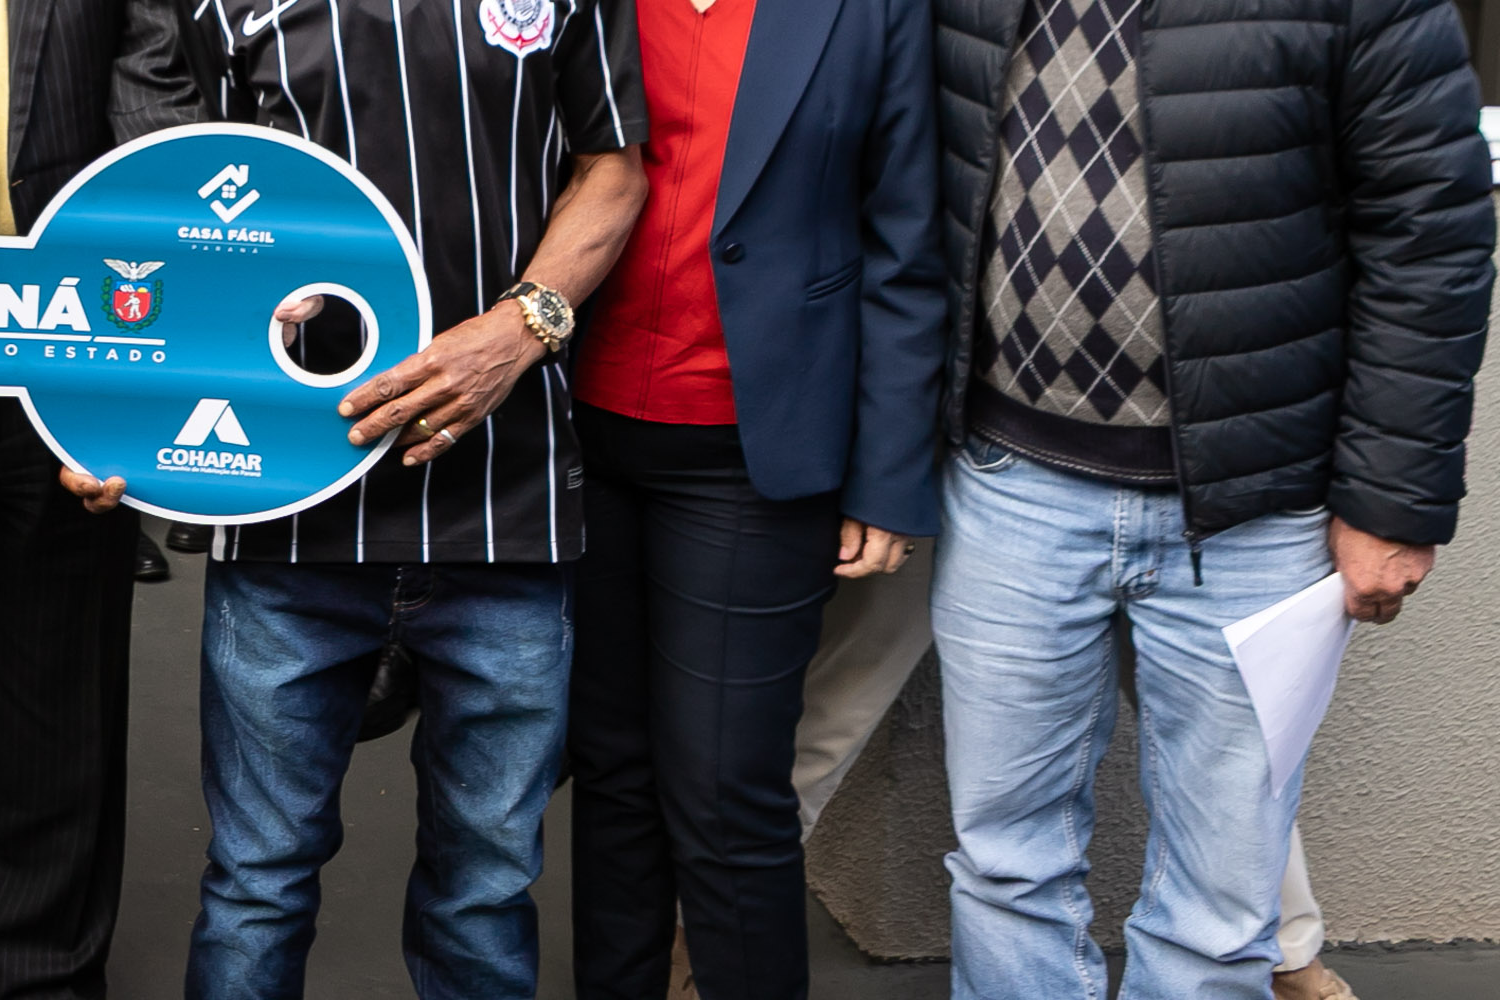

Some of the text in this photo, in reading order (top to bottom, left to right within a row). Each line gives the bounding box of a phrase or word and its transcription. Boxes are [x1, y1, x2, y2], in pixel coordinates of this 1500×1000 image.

[178, 226, 275, 244] CASA FÁCIL
[44, 344, 166, 364] ESTADO
[157, 447, 262, 471] COHAPAR
